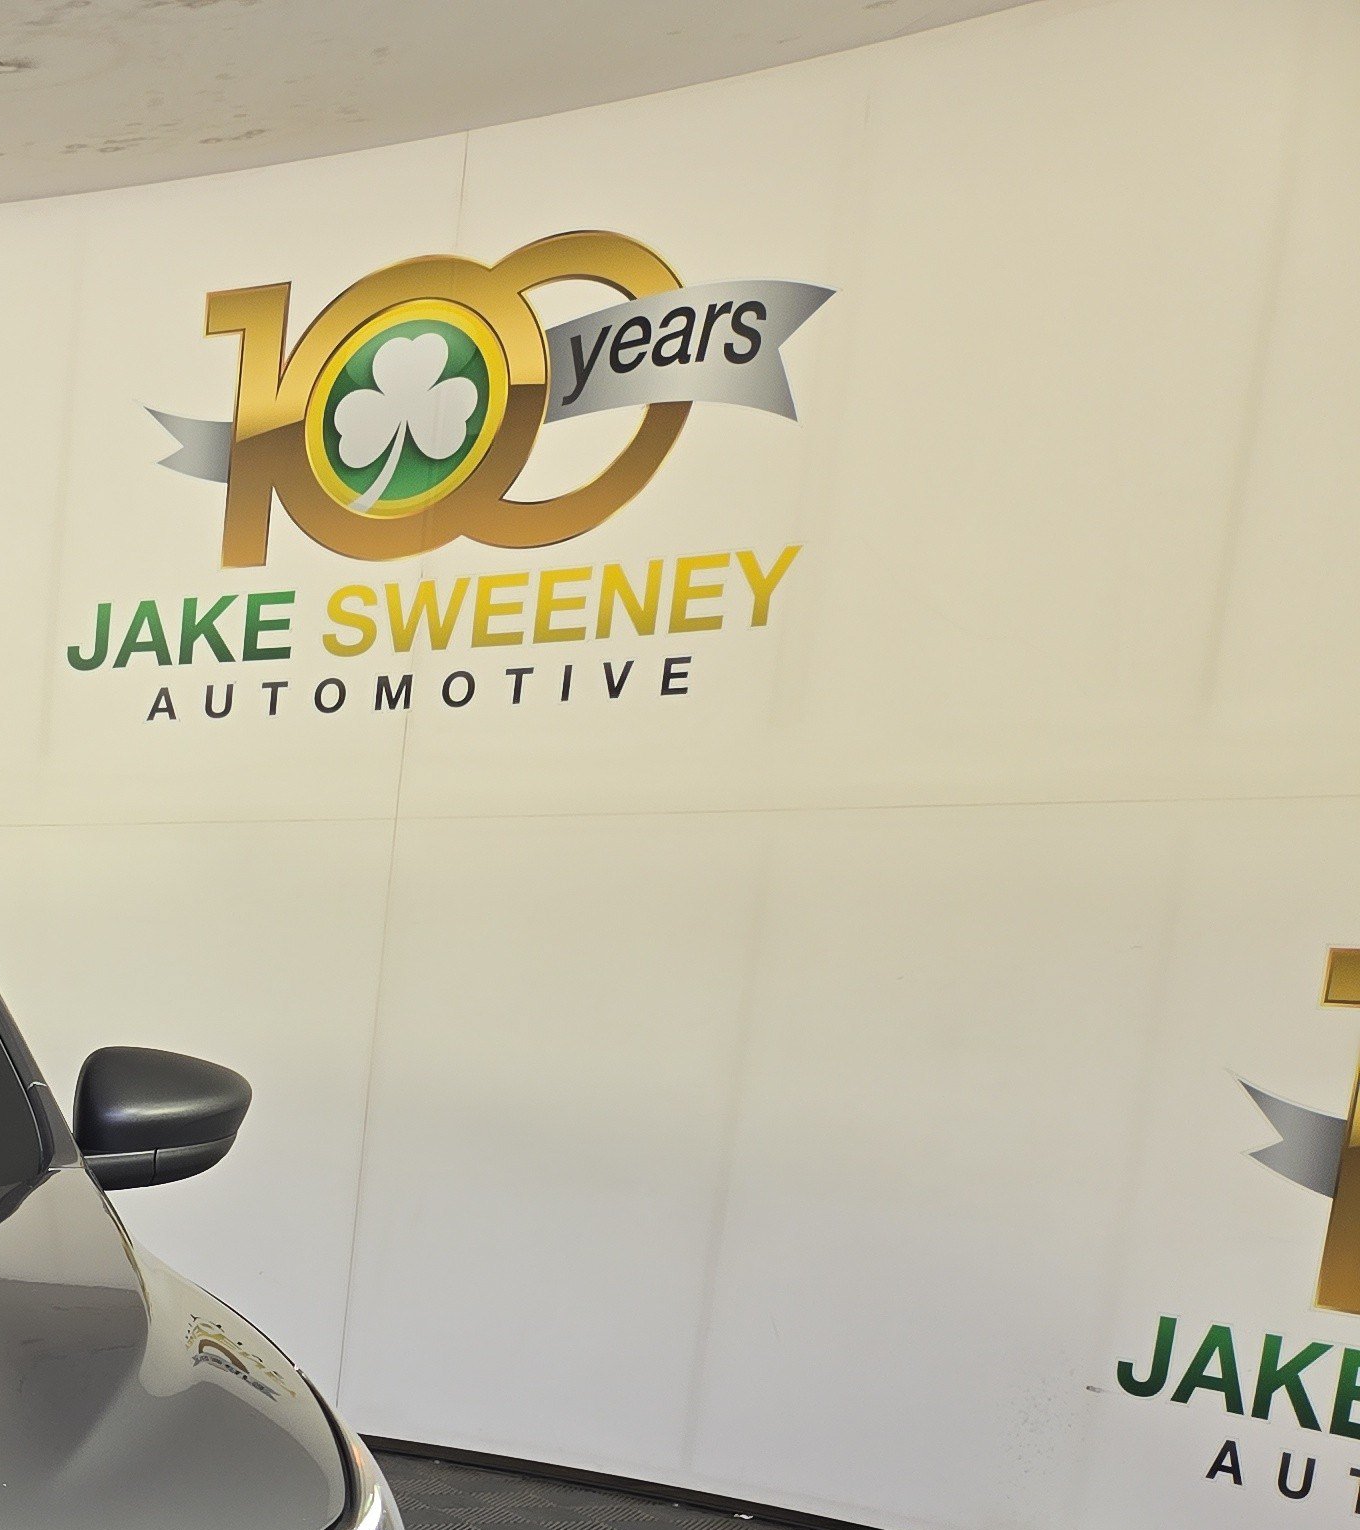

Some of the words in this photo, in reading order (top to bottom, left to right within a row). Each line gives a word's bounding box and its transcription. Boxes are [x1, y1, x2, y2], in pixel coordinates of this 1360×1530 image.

[205, 229, 693, 570] 100
[561, 297, 768, 407] years
[66, 590, 297, 672] JAKE
[321, 545, 804, 659] SWEENEY
[146, 656, 693, 722] AUTOMOTIVE
